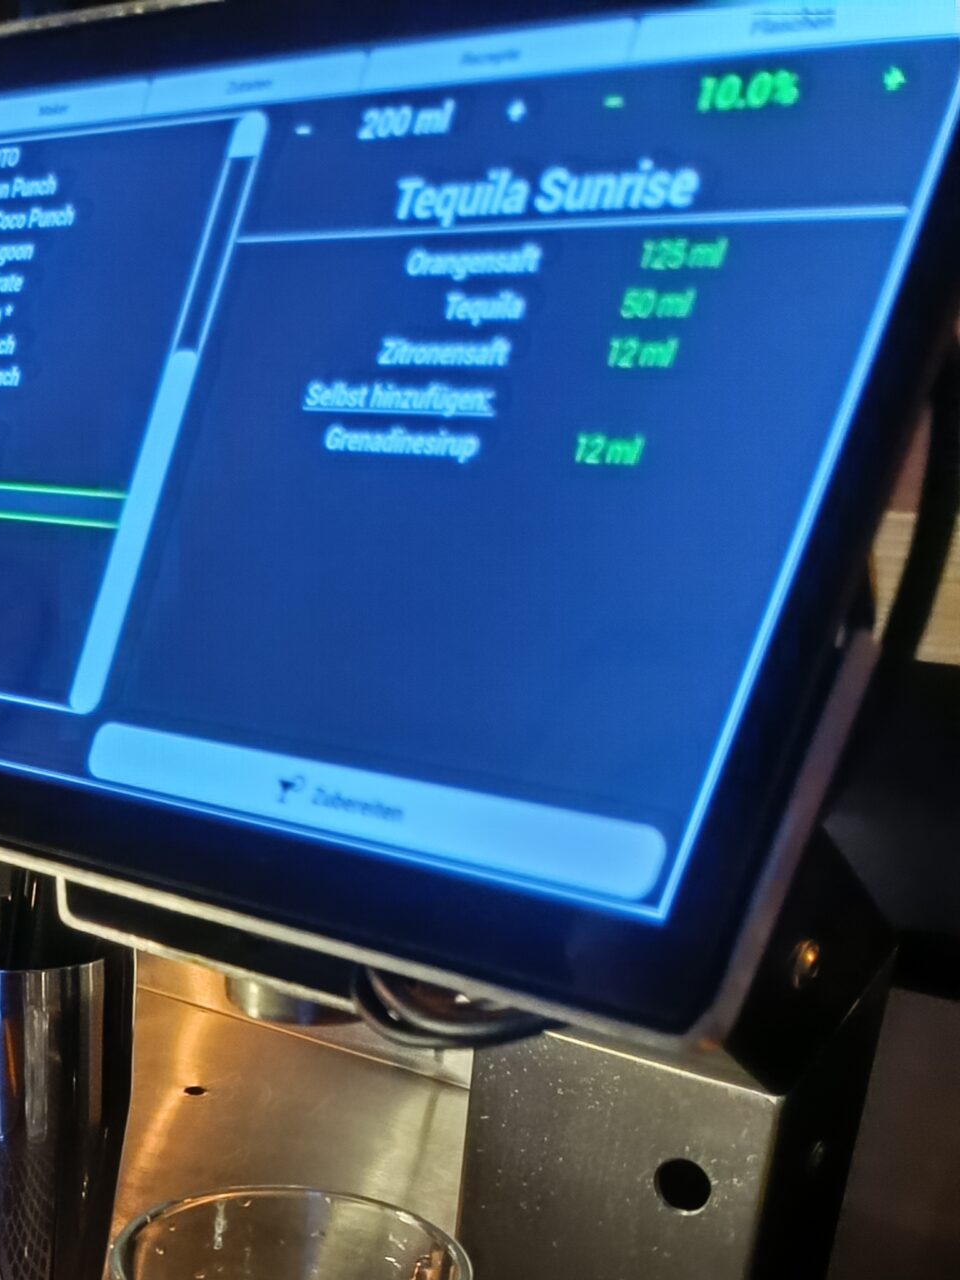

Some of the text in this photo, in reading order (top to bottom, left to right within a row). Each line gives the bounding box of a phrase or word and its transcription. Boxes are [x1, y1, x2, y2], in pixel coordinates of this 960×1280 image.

[697, 68, 800, 114] 10.0%
[357, 97, 456, 140] 200 ml
[396, 156, 700, 229] Tequila Sunrise
[406, 242, 542, 281] Orangensaft
[641, 238, 688, 270] 125
[445, 288, 527, 327] Tequila
[620, 287, 657, 319] 50
[377, 333, 511, 367] Zitronensaft
[608, 336, 640, 368] 12
[304, 379, 369, 409] Selbst
[324, 422, 481, 464] Grenadinesirup
[575, 432, 606, 465] 12
